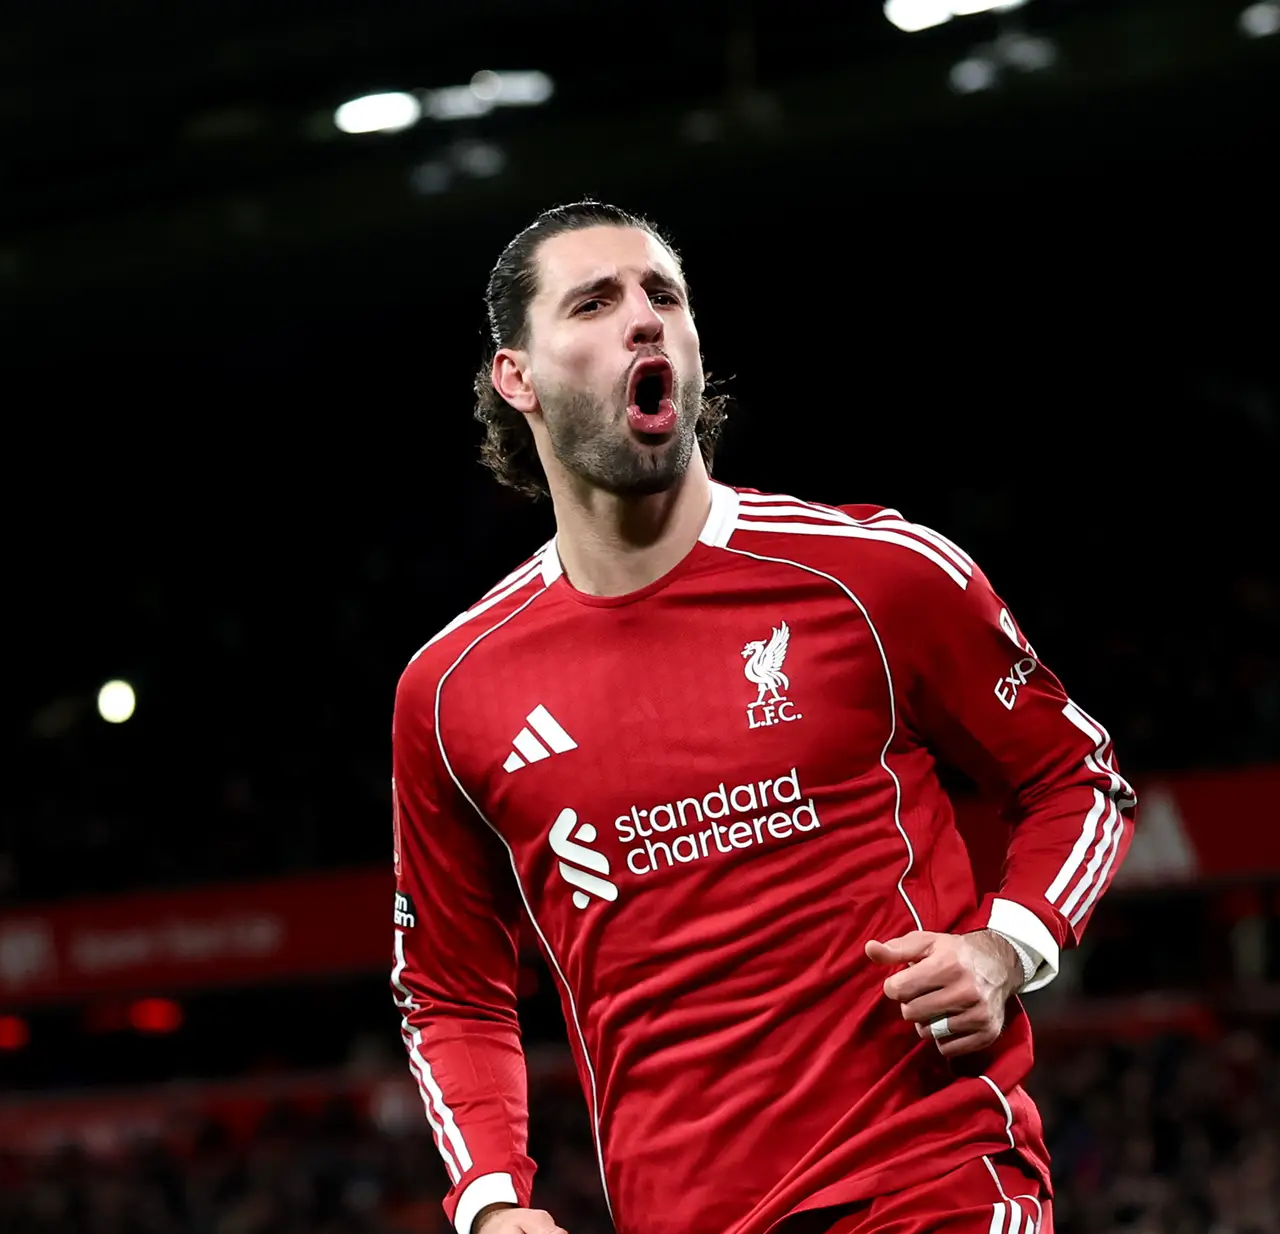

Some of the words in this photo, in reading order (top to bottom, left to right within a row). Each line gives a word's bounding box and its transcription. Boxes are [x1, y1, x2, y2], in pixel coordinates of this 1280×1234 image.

[746, 701, 803, 729] L.F.C.
[614, 767, 802, 843] standard
[626, 798, 821, 875] chartered
